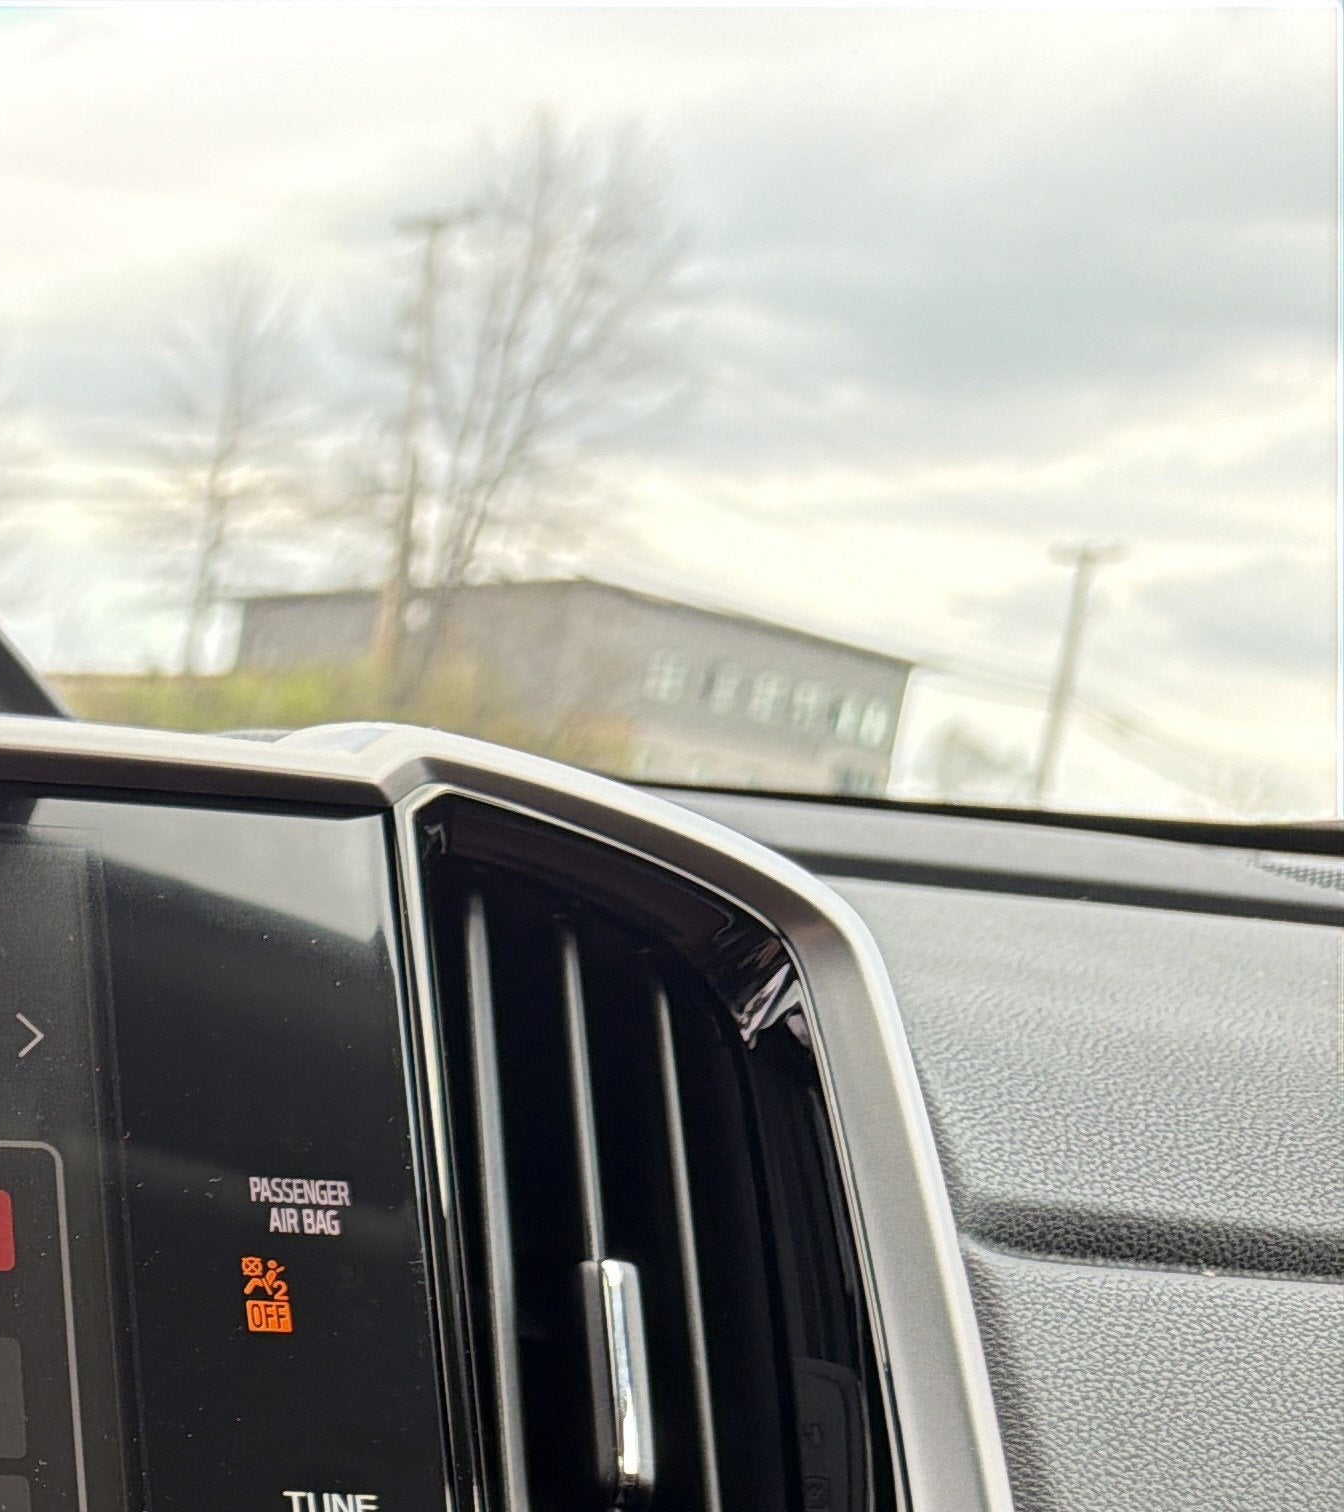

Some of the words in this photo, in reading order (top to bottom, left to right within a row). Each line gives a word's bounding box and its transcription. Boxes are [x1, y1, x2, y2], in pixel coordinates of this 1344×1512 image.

[248, 1176, 351, 1207] PASSENGER
[268, 1207, 301, 1234] AIR
[301, 1208, 341, 1236] BAG
[249, 1303, 289, 1330] OFF
